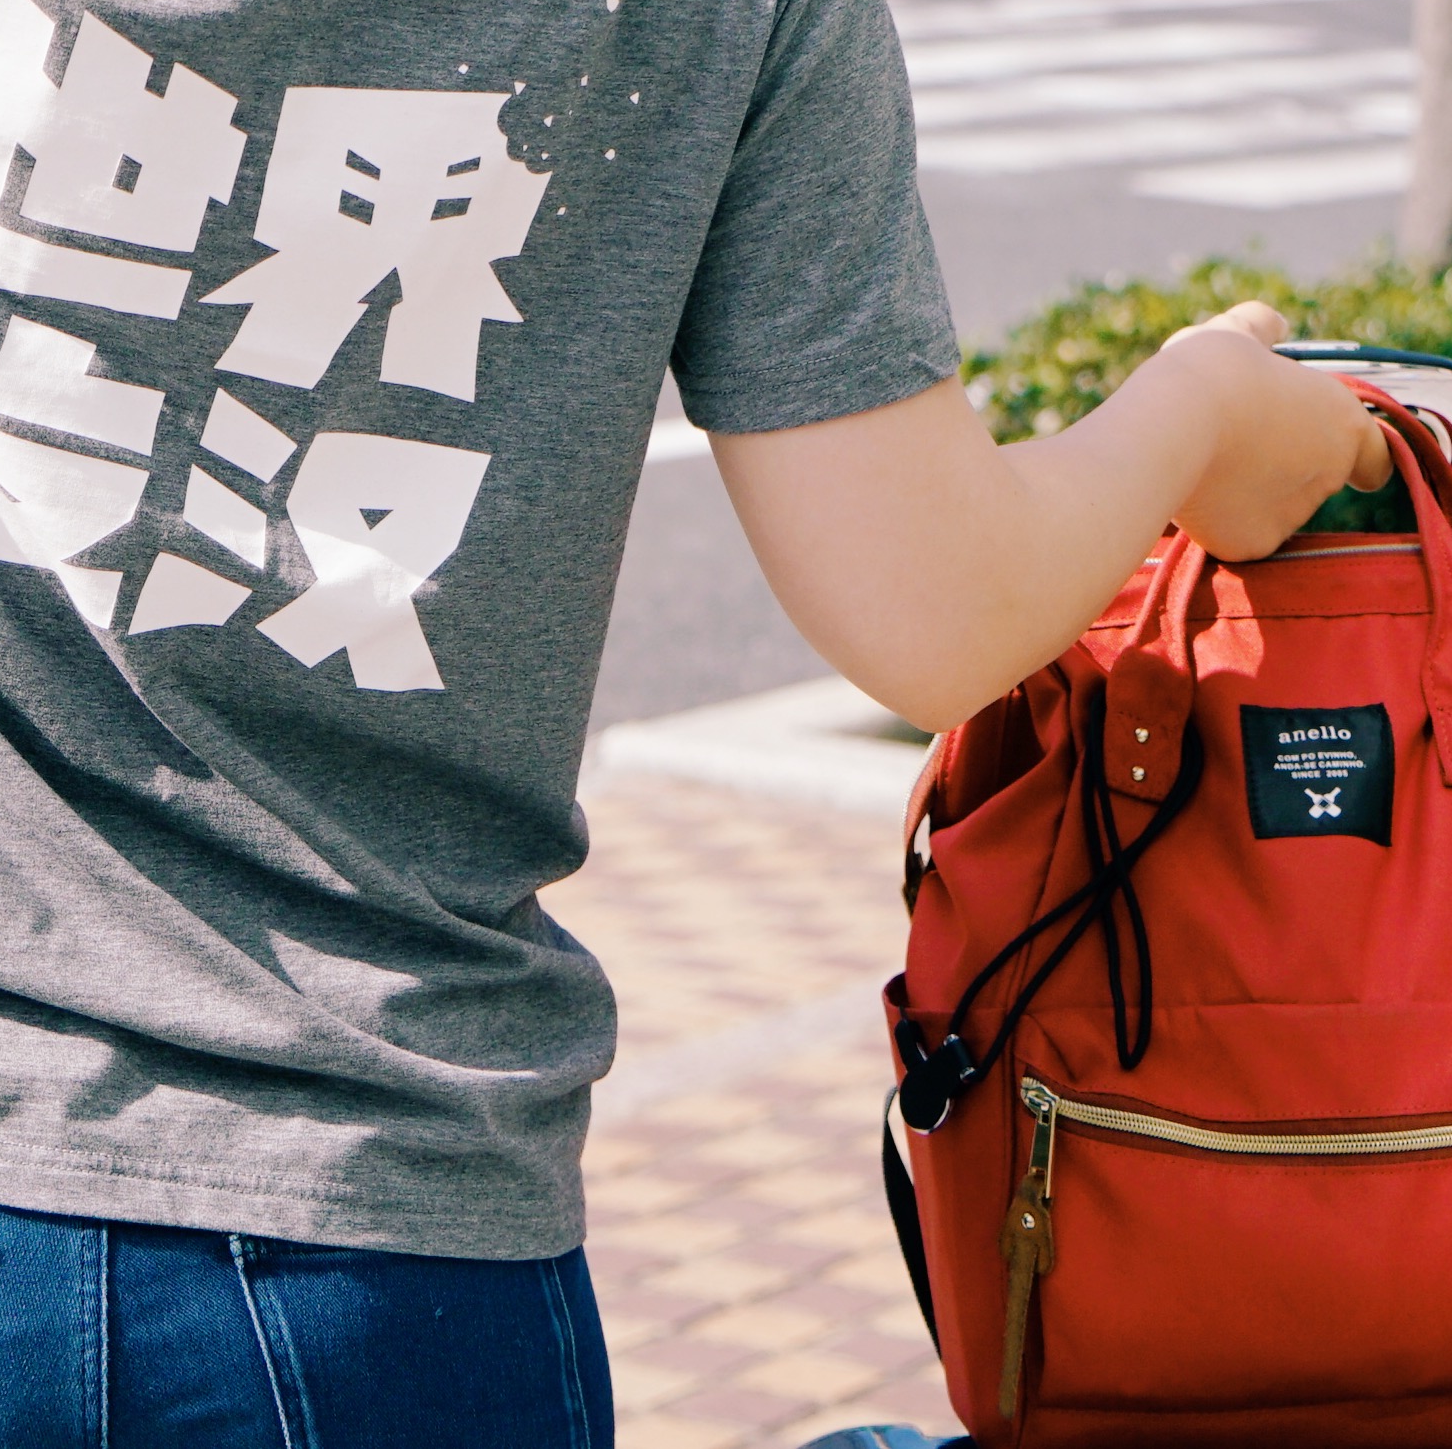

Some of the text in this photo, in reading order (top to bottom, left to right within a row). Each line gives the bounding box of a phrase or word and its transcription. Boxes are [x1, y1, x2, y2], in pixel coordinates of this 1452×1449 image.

[1278, 725, 1352, 744] anello
[1277, 754, 1300, 762] COM
[1300, 752, 1316, 761] PO
[1291, 770, 1321, 779] SINCE
